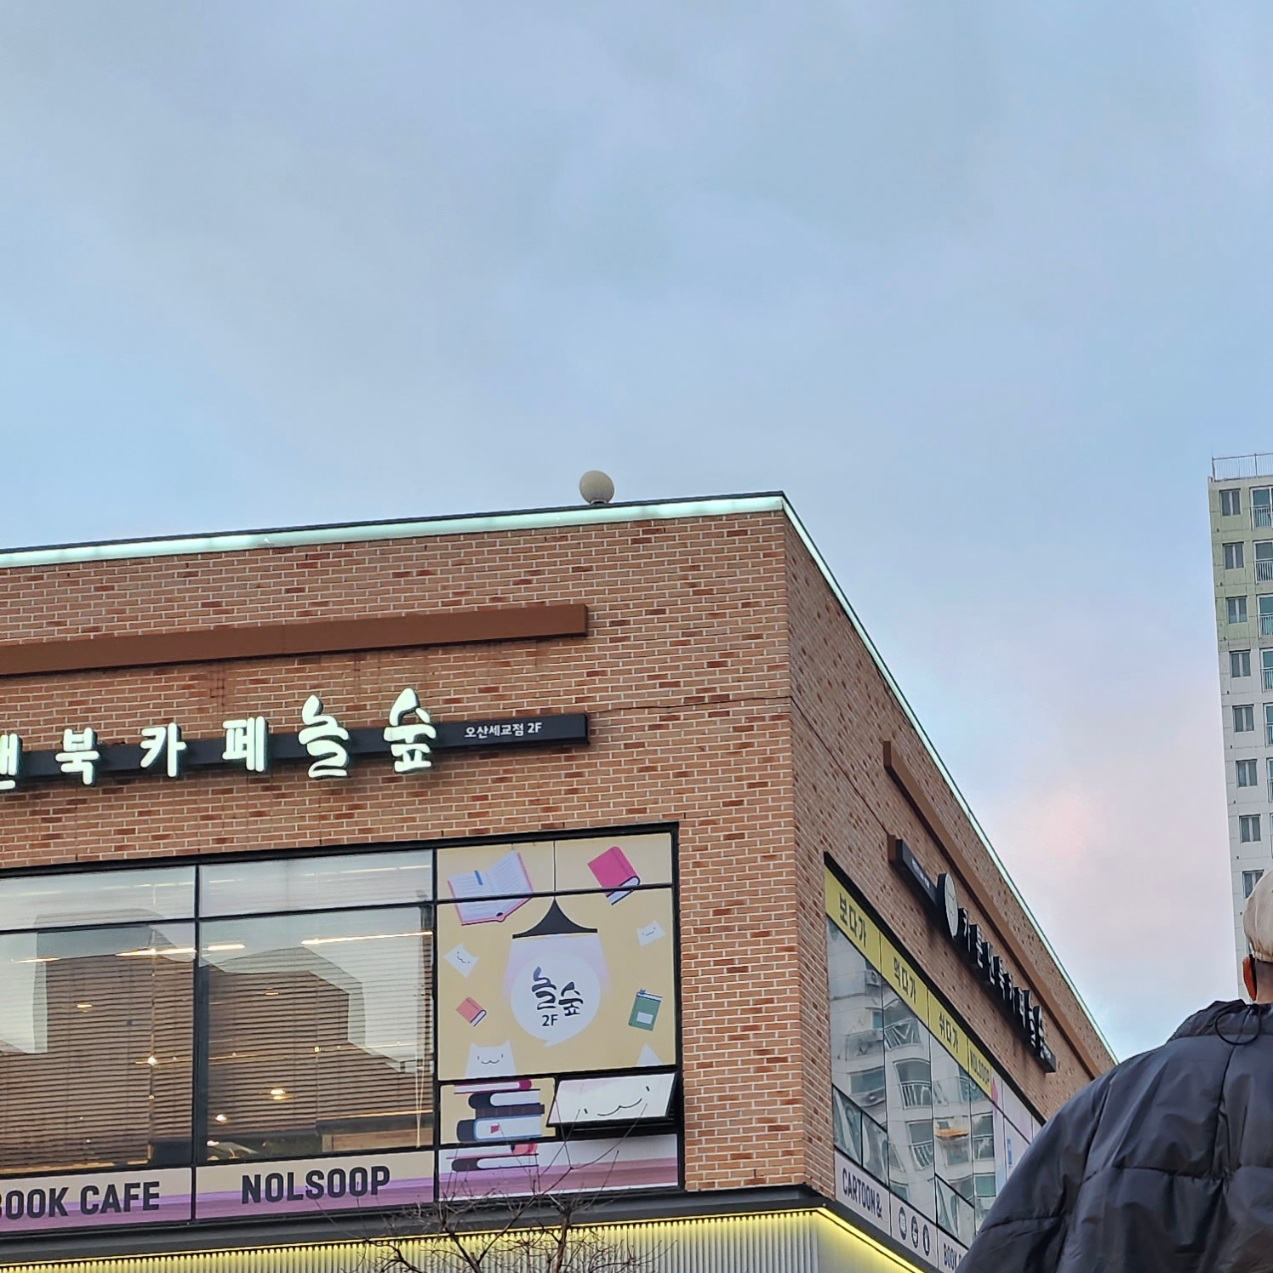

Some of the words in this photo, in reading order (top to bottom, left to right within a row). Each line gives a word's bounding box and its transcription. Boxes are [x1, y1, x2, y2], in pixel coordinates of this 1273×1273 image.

[463, 723, 525, 739] 오산세교점
[526, 721, 543, 734] 2F
[838, 891, 868, 948] 보다가
[893, 957, 917, 1004] 먹다가
[541, 1013, 559, 1027] 2F
[938, 1011, 960, 1054] 쉬다가
[0, 1186, 70, 1221] OOK
[79, 1180, 160, 1216] CAFE
[241, 1164, 391, 1205] NOLSOOP
